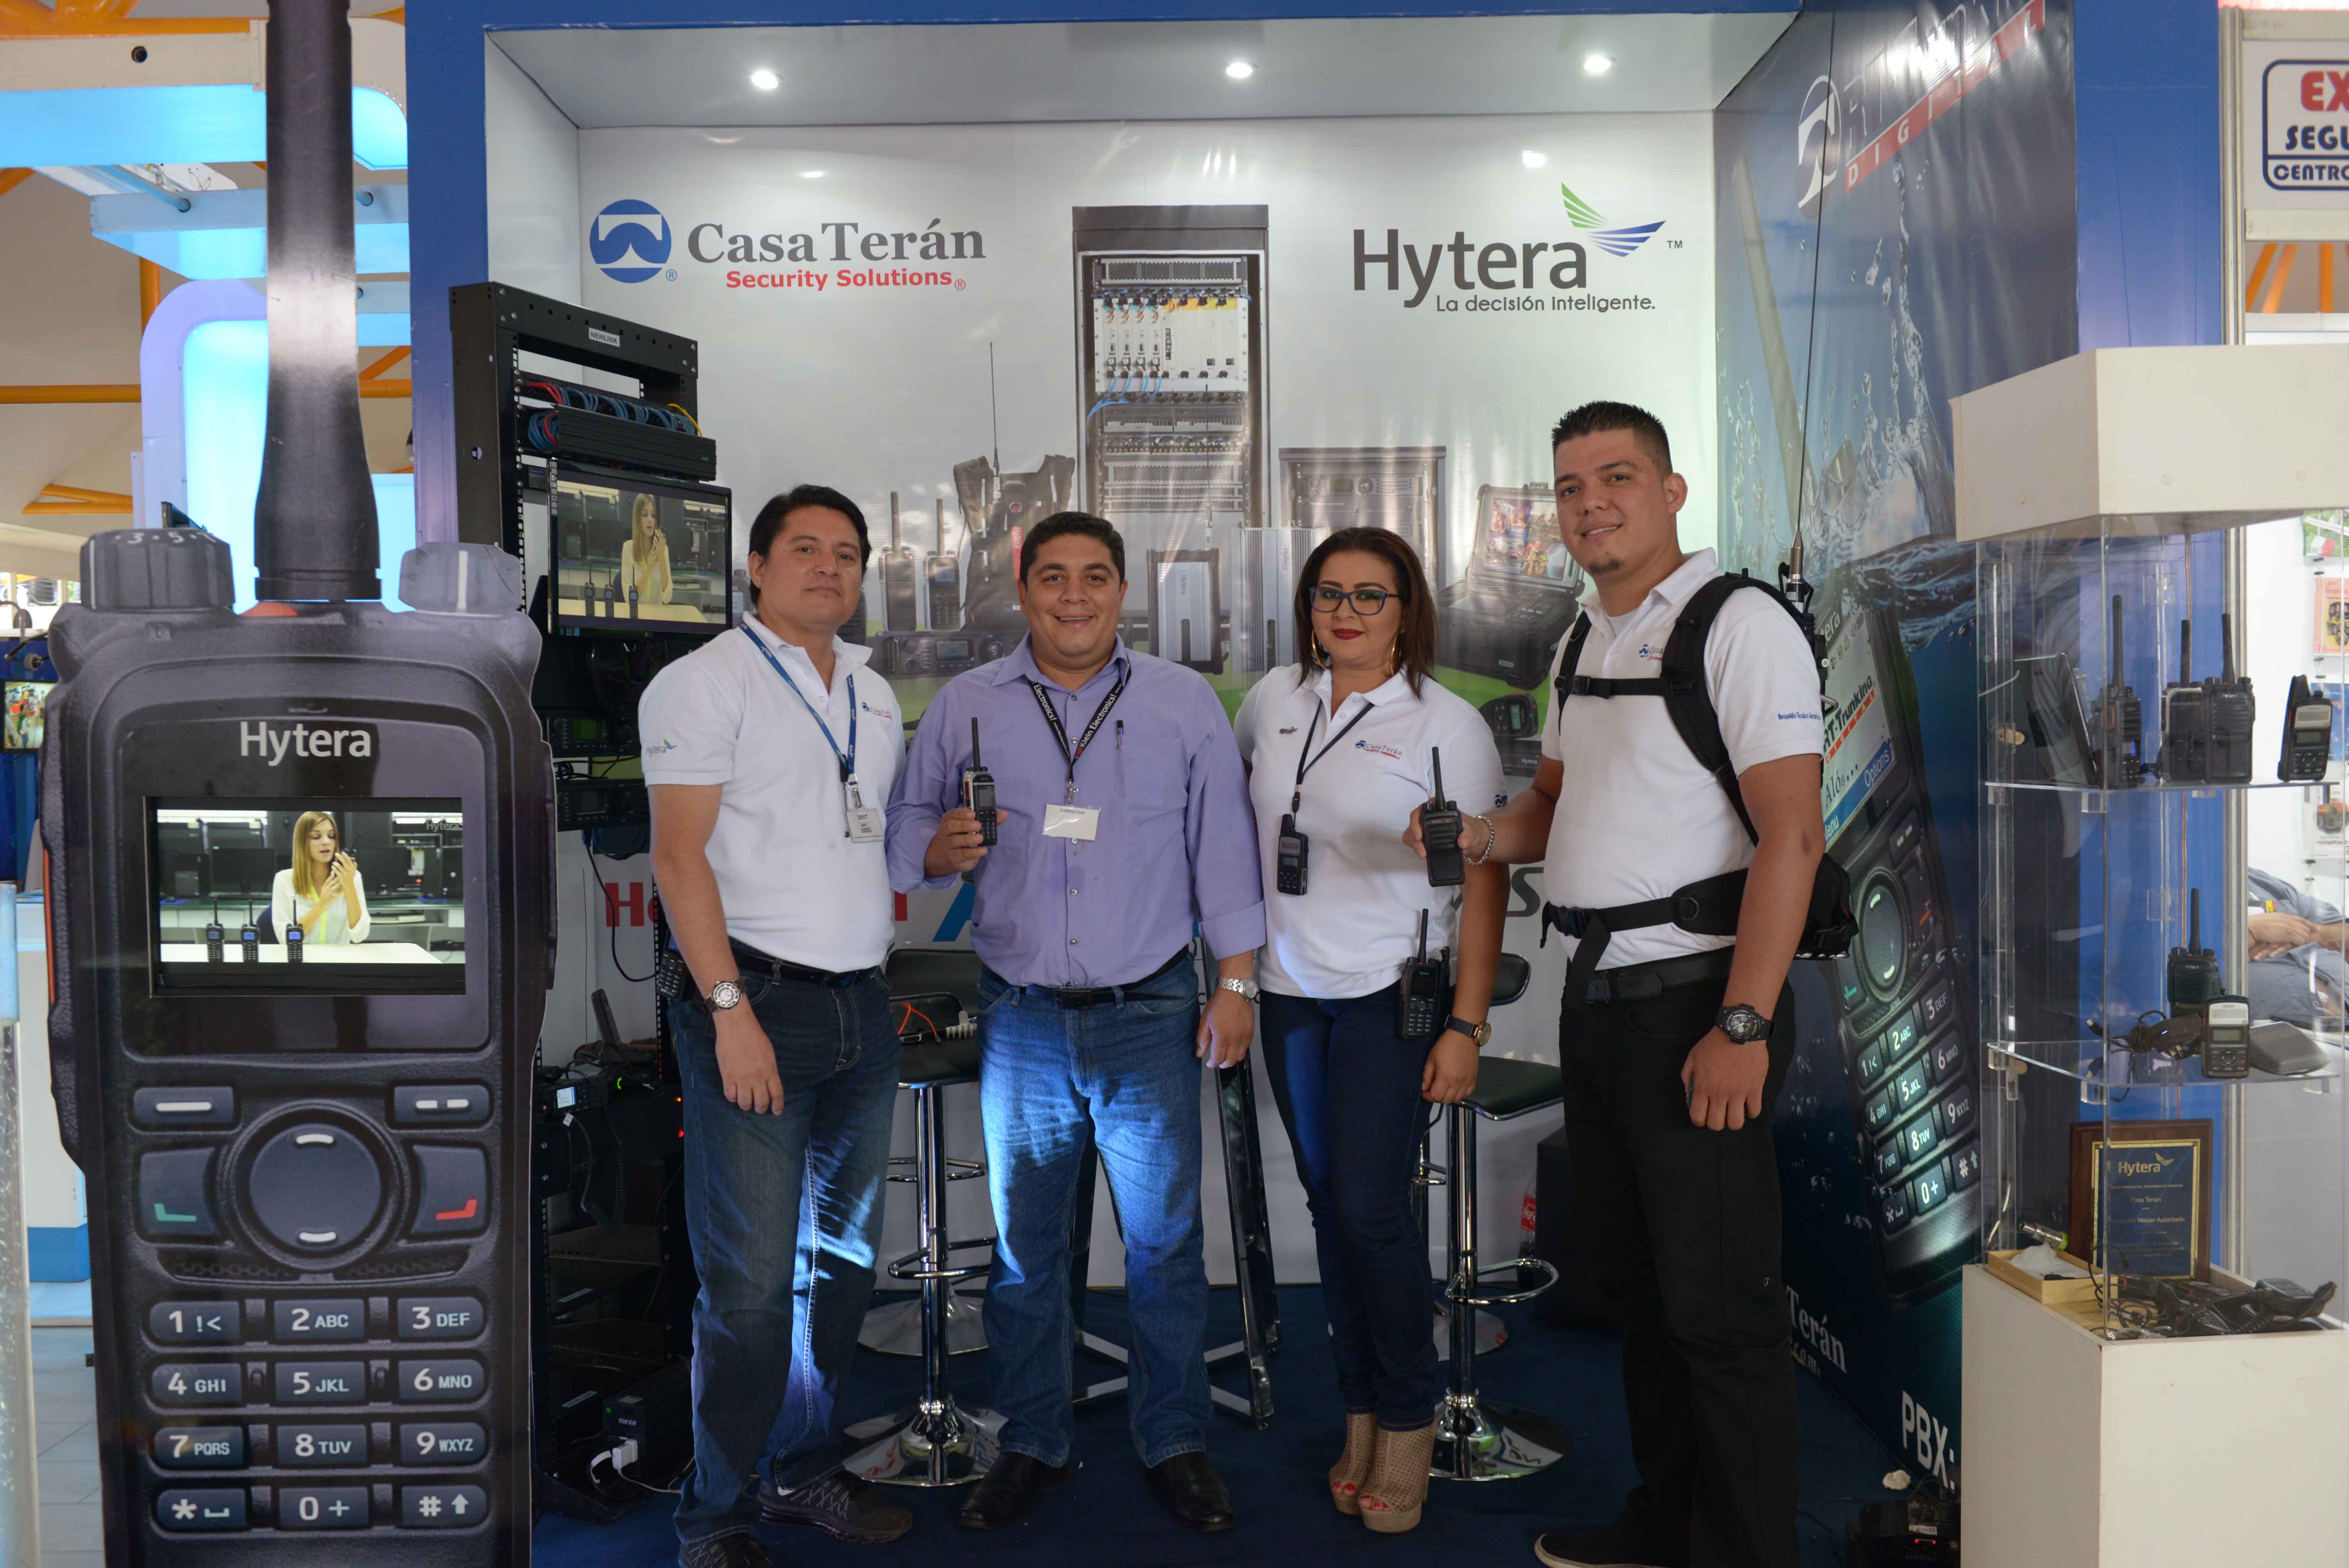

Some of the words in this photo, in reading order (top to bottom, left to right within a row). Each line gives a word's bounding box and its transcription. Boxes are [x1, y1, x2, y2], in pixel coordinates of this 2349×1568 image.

[1353, 228, 1587, 308] Hytera
[726, 270, 828, 291] Security
[1436, 296, 1458, 312] La
[1465, 294, 1545, 312] decisión
[1552, 294, 1656, 313] inteligente.
[590, 330, 618, 344] NEWLINK
[1034, 684, 1057, 721] Electronics!
[1080, 730, 1094, 748] Klein
[1089, 693, 1117, 729] Electronics!
[1827, 694, 1874, 763] DIGITAL
[241, 722, 371, 767] Hytera
[1864, 749, 1890, 788] Options
[426, 821, 460, 832] Hytera
[1824, 816, 1839, 841] enu
[1927, 998, 1935, 1019] 3
[1935, 992, 1947, 1012] DEF
[1893, 1031, 1901, 1051] 2
[1900, 1026, 1911, 1044] ABC
[1938, 1049, 1946, 1070] 6
[1902, 1080, 1909, 1101] 5
[1910, 1078, 1921, 1094] JKL
[1870, 1107, 1876, 1124] 4
[1877, 1104, 1887, 1120] GHI
[1948, 1103, 1956, 1124] 9
[1911, 1130, 1919, 1151] 8
[1919, 1128, 1930, 1145] TUV
[2118, 1161, 2161, 1176] Hytera
[1921, 1182, 1930, 1204] 0
[169, 1310, 184, 1333] 1
[291, 1308, 310, 1331] 2
[315, 1314, 349, 1328] ABC
[412, 1307, 430, 1329] 3
[436, 1312, 470, 1327] DEF
[1786, 1285, 1848, 1374] Terán
[168, 1372, 187, 1395] 4
[195, 1379, 226, 1393] GHI
[293, 1372, 310, 1395] 5
[315, 1378, 349, 1393] JKL
[414, 1368, 433, 1391] 6
[438, 1375, 472, 1388] MNO
[169, 1435, 189, 1458] 7
[194, 1442, 230, 1456] PQRS
[295, 1434, 314, 1457] 8
[318, 1441, 351, 1454] TUV
[416, 1432, 435, 1454] 9
[439, 1438, 473, 1452] WXYZ
[299, 1497, 319, 1521] 0
